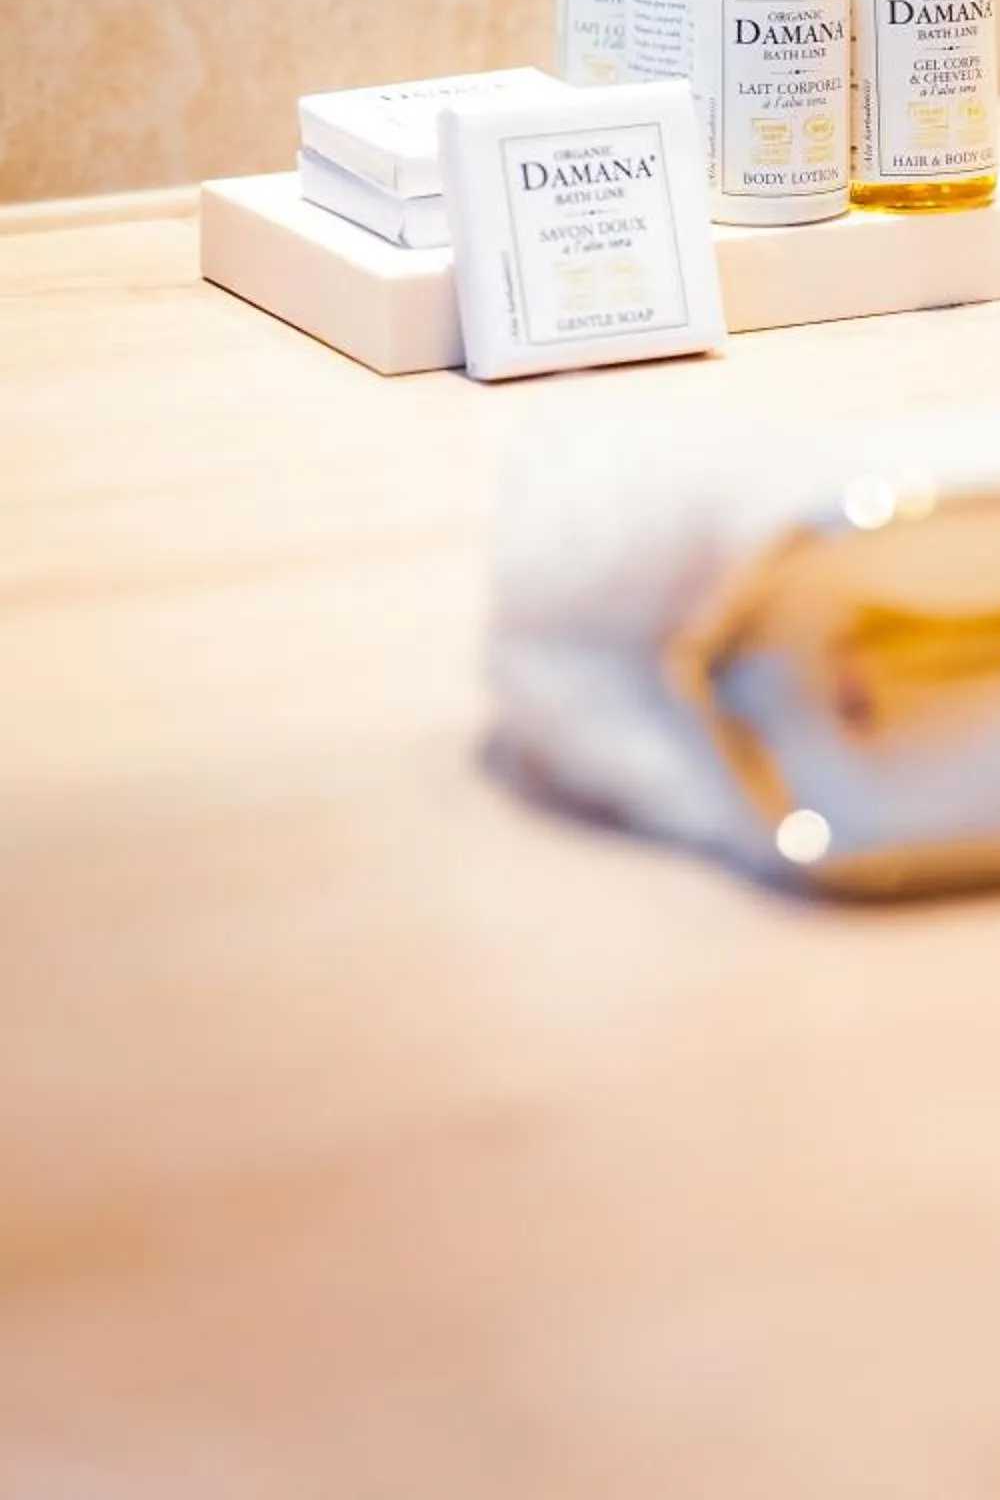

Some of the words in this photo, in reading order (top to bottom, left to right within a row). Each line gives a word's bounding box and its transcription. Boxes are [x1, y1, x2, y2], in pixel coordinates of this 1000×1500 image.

[767, 8, 826, 22] ORGANIC
[735, 18, 845, 45] DAMANA
[916, 28, 952, 41] BATH
[954, 25, 979, 38] LINE
[763, 49, 799, 61] BATH
[800, 47, 827, 60] LINE
[913, 58, 941, 71] GEL
[943, 54, 981, 69] CORPS
[910, 74, 921, 85] &
[923, 67, 984, 83] CHEVEUX
[738, 82, 773, 95] LAIT
[776, 77, 844, 96] CORPOREL
[892, 154, 929, 167] HAIR
[931, 154, 941, 166] &
[944, 149, 980, 165] BODY
[520, 156, 653, 192] DAMANA
[743, 171, 788, 186] BODY
[791, 167, 840, 186] LOTION
[554, 191, 593, 206] BATH
[595, 187, 626, 202] LINE
[539, 223, 595, 243] SAVON
[597, 216, 648, 236] DOUX
[556, 312, 614, 331] GENTLE
[616, 307, 655, 324] SOAP
